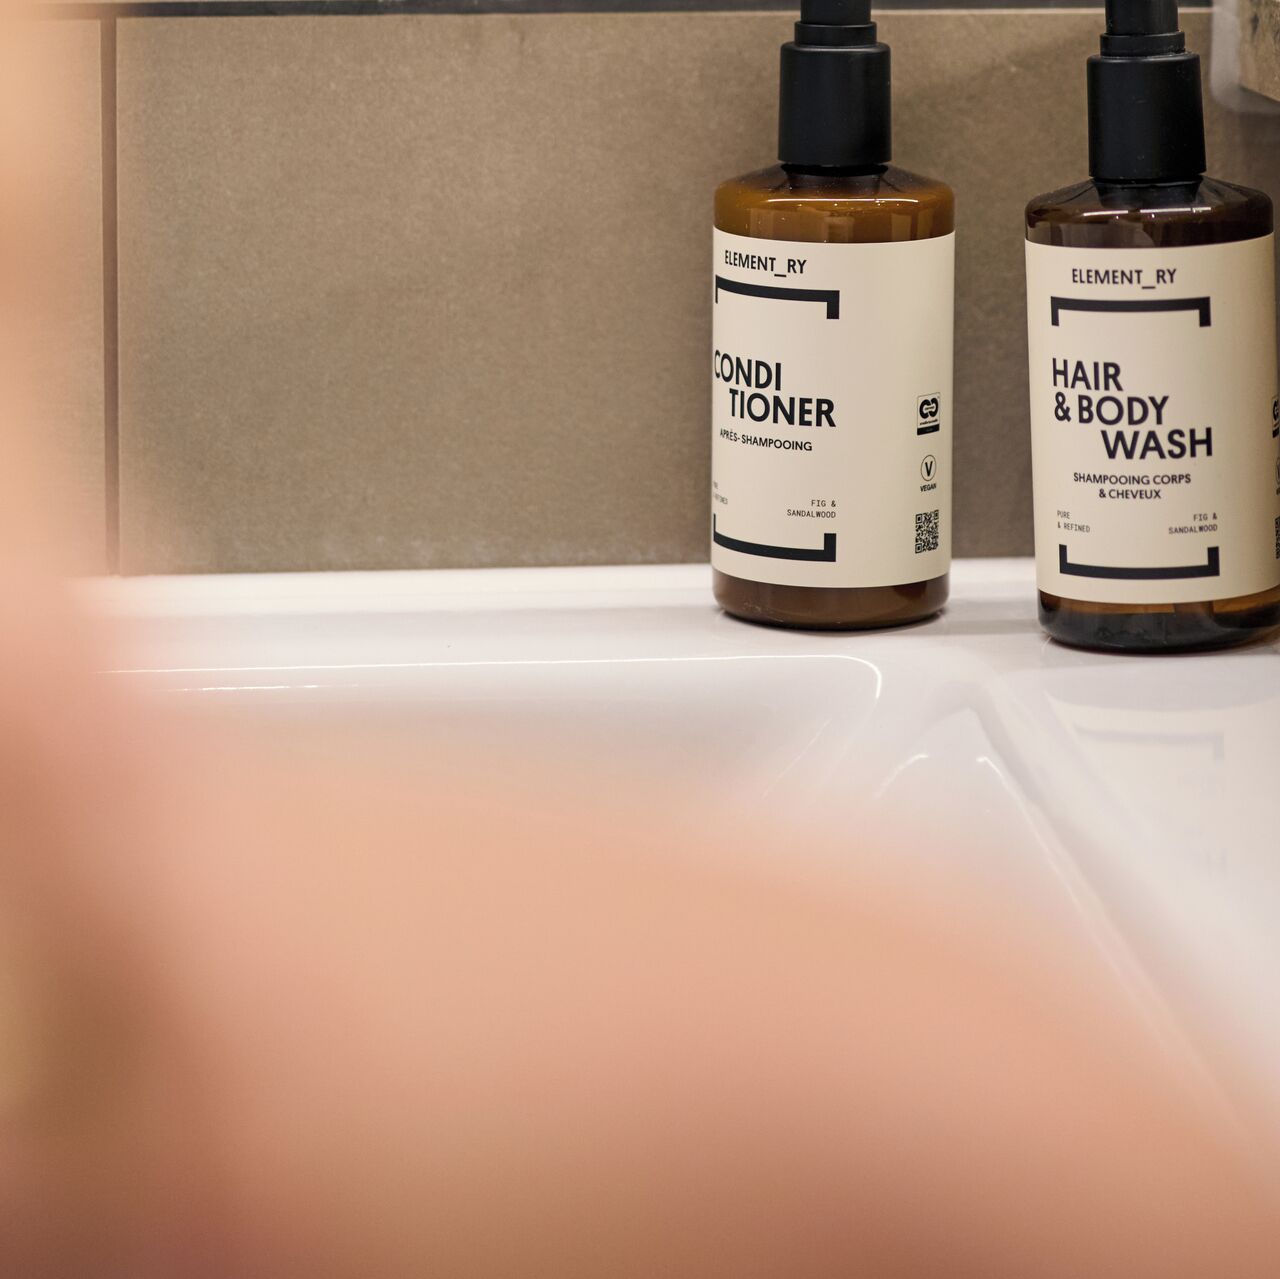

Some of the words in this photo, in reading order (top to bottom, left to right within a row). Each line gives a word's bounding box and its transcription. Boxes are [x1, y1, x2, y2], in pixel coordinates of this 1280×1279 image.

[724, 250, 807, 277] ELEMENT_RY
[1071, 268, 1177, 289] ELEMENT_RY
[714, 349, 782, 391] CONDI
[1052, 358, 1123, 391] HAIR
[729, 388, 836, 427] TIONER
[1054, 392, 1071, 422] &
[1079, 395, 1169, 425] BODY
[1101, 427, 1213, 460] WASH
[1073, 472, 1151, 486] SHAMPOOING
[1153, 474, 1191, 485] CORPS
[920, 482, 937, 492] VEGAN
[1099, 488, 1106, 498] &
[1109, 488, 1161, 499] CHEVEUX
[811, 499, 827, 508] FIG
[831, 500, 836, 508] &
[787, 509, 836, 519] SANDALWOOD
[1057, 510, 1070, 520] PURE
[1193, 512, 1209, 522] FIG
[1063, 522, 1090, 533] REFINED
[1168, 523, 1218, 534] SANDALWOOD
